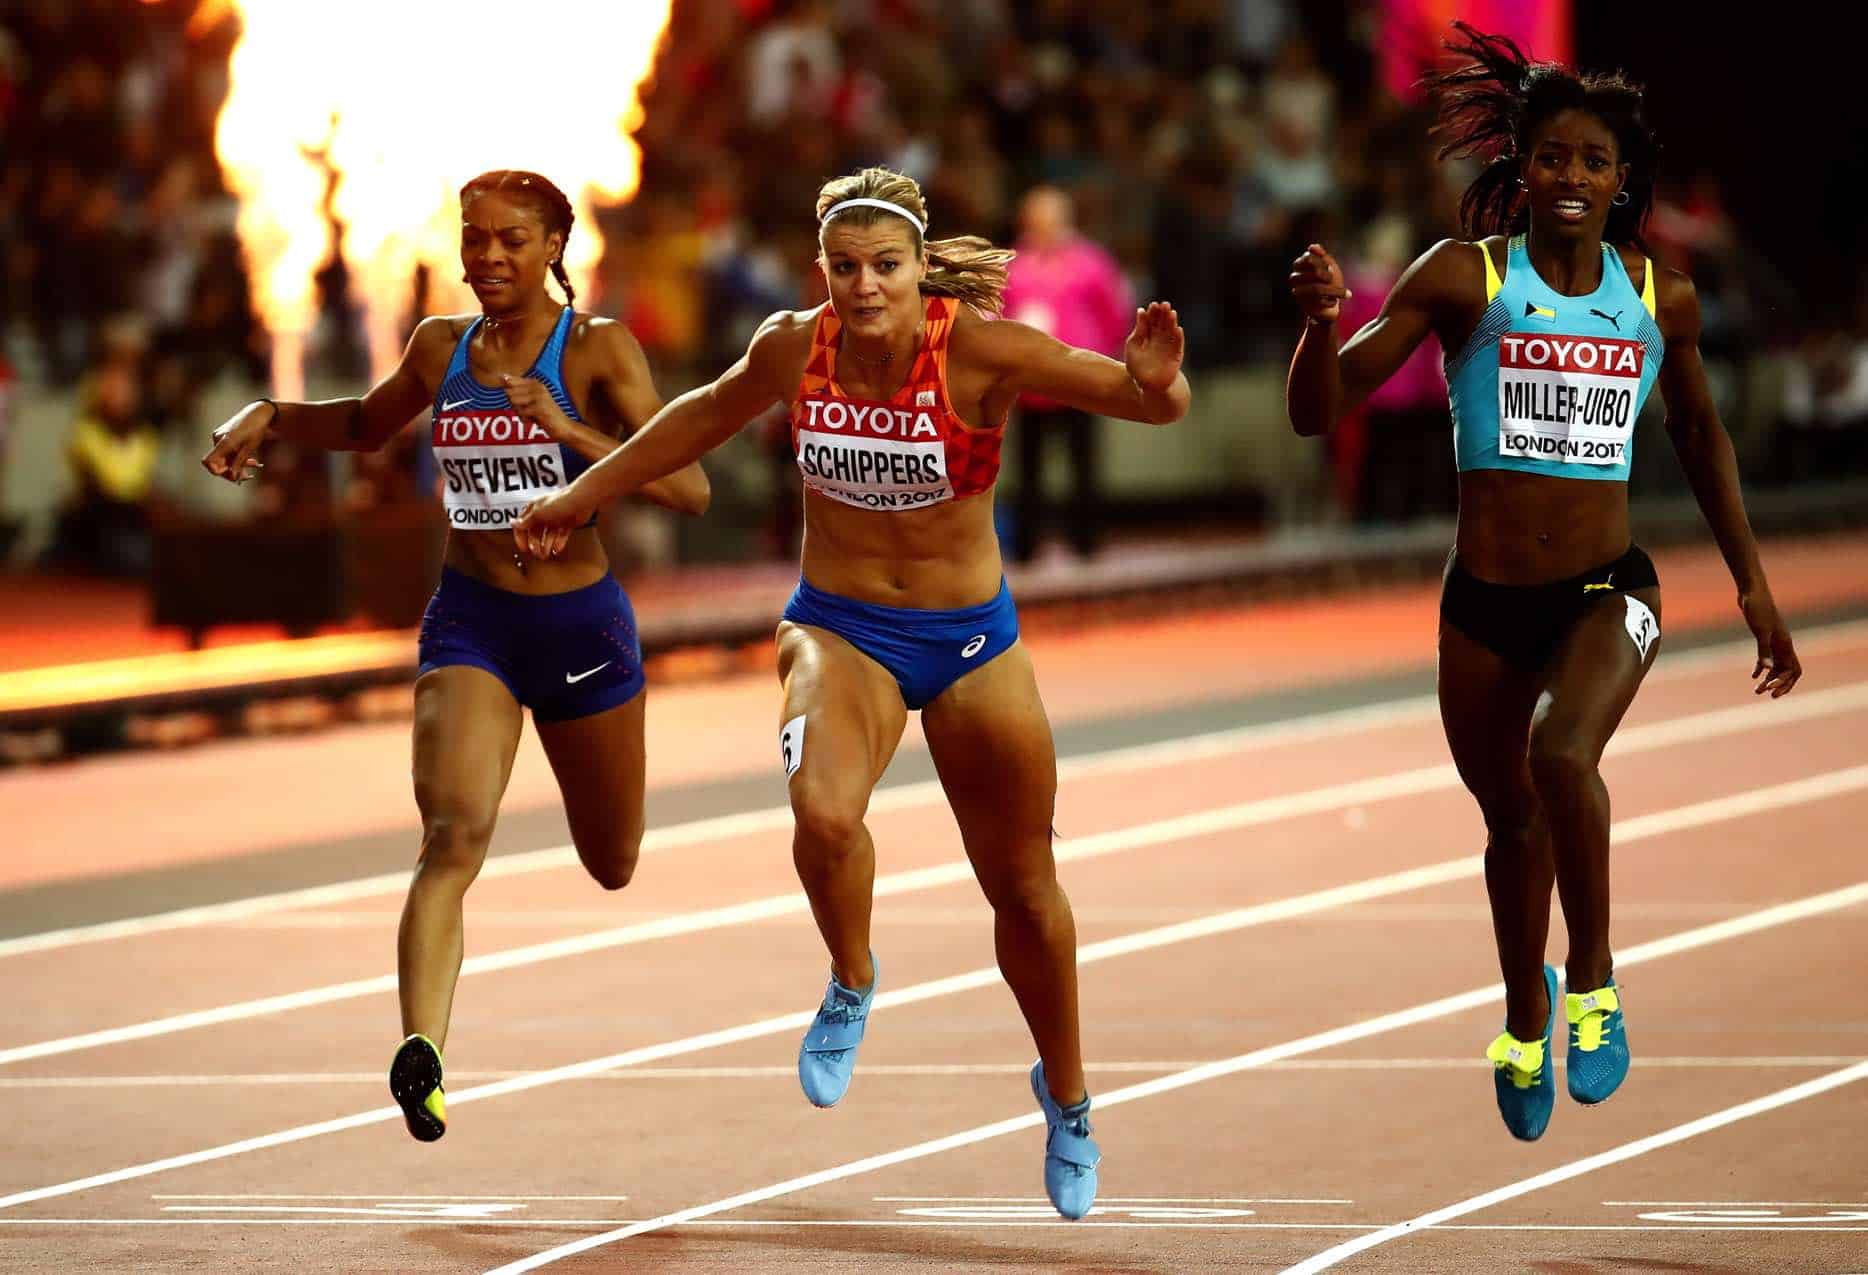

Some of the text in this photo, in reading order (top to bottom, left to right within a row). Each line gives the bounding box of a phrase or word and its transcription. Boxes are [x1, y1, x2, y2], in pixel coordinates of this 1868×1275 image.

[1503, 338, 1637, 373] TOYOTA
[806, 400, 938, 437] TOYOTA
[1504, 381, 1631, 428] MILLER-UIBO
[803, 443, 940, 485] SCHIPPERS
[1505, 434, 1624, 458] LONDON 2017
[442, 454, 559, 494] STEVENS
